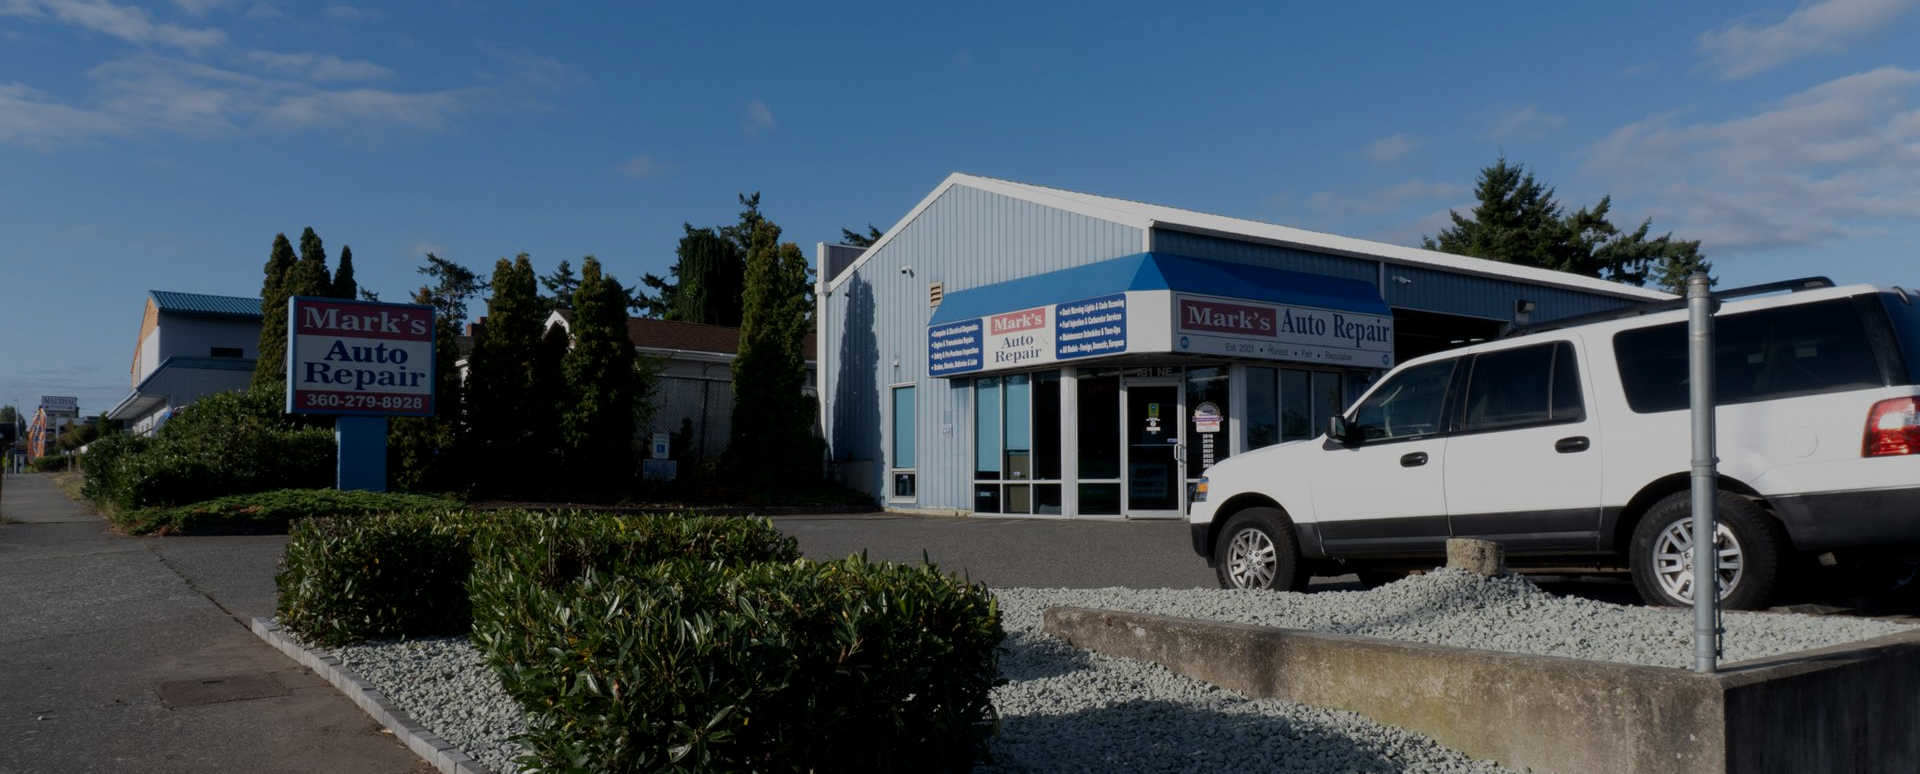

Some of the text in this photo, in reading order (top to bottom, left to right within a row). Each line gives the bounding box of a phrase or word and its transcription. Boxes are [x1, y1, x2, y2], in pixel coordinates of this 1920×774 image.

[304, 306, 426, 335] Mark's
[994, 313, 1042, 331] Mark's
[1187, 306, 1390, 347] Mark's Auto Repair
[1002, 335, 1033, 349] Auto
[325, 340, 408, 364] Auto
[995, 346, 1042, 363] Repair
[1240, 344, 1254, 353] 2003
[1268, 344, 1288, 356] Honest
[1302, 349, 1312, 358] Fair
[304, 362, 425, 390] Repair
[1137, 367, 1172, 377] 181 NE
[306, 394, 422, 409] 360-279-8928
